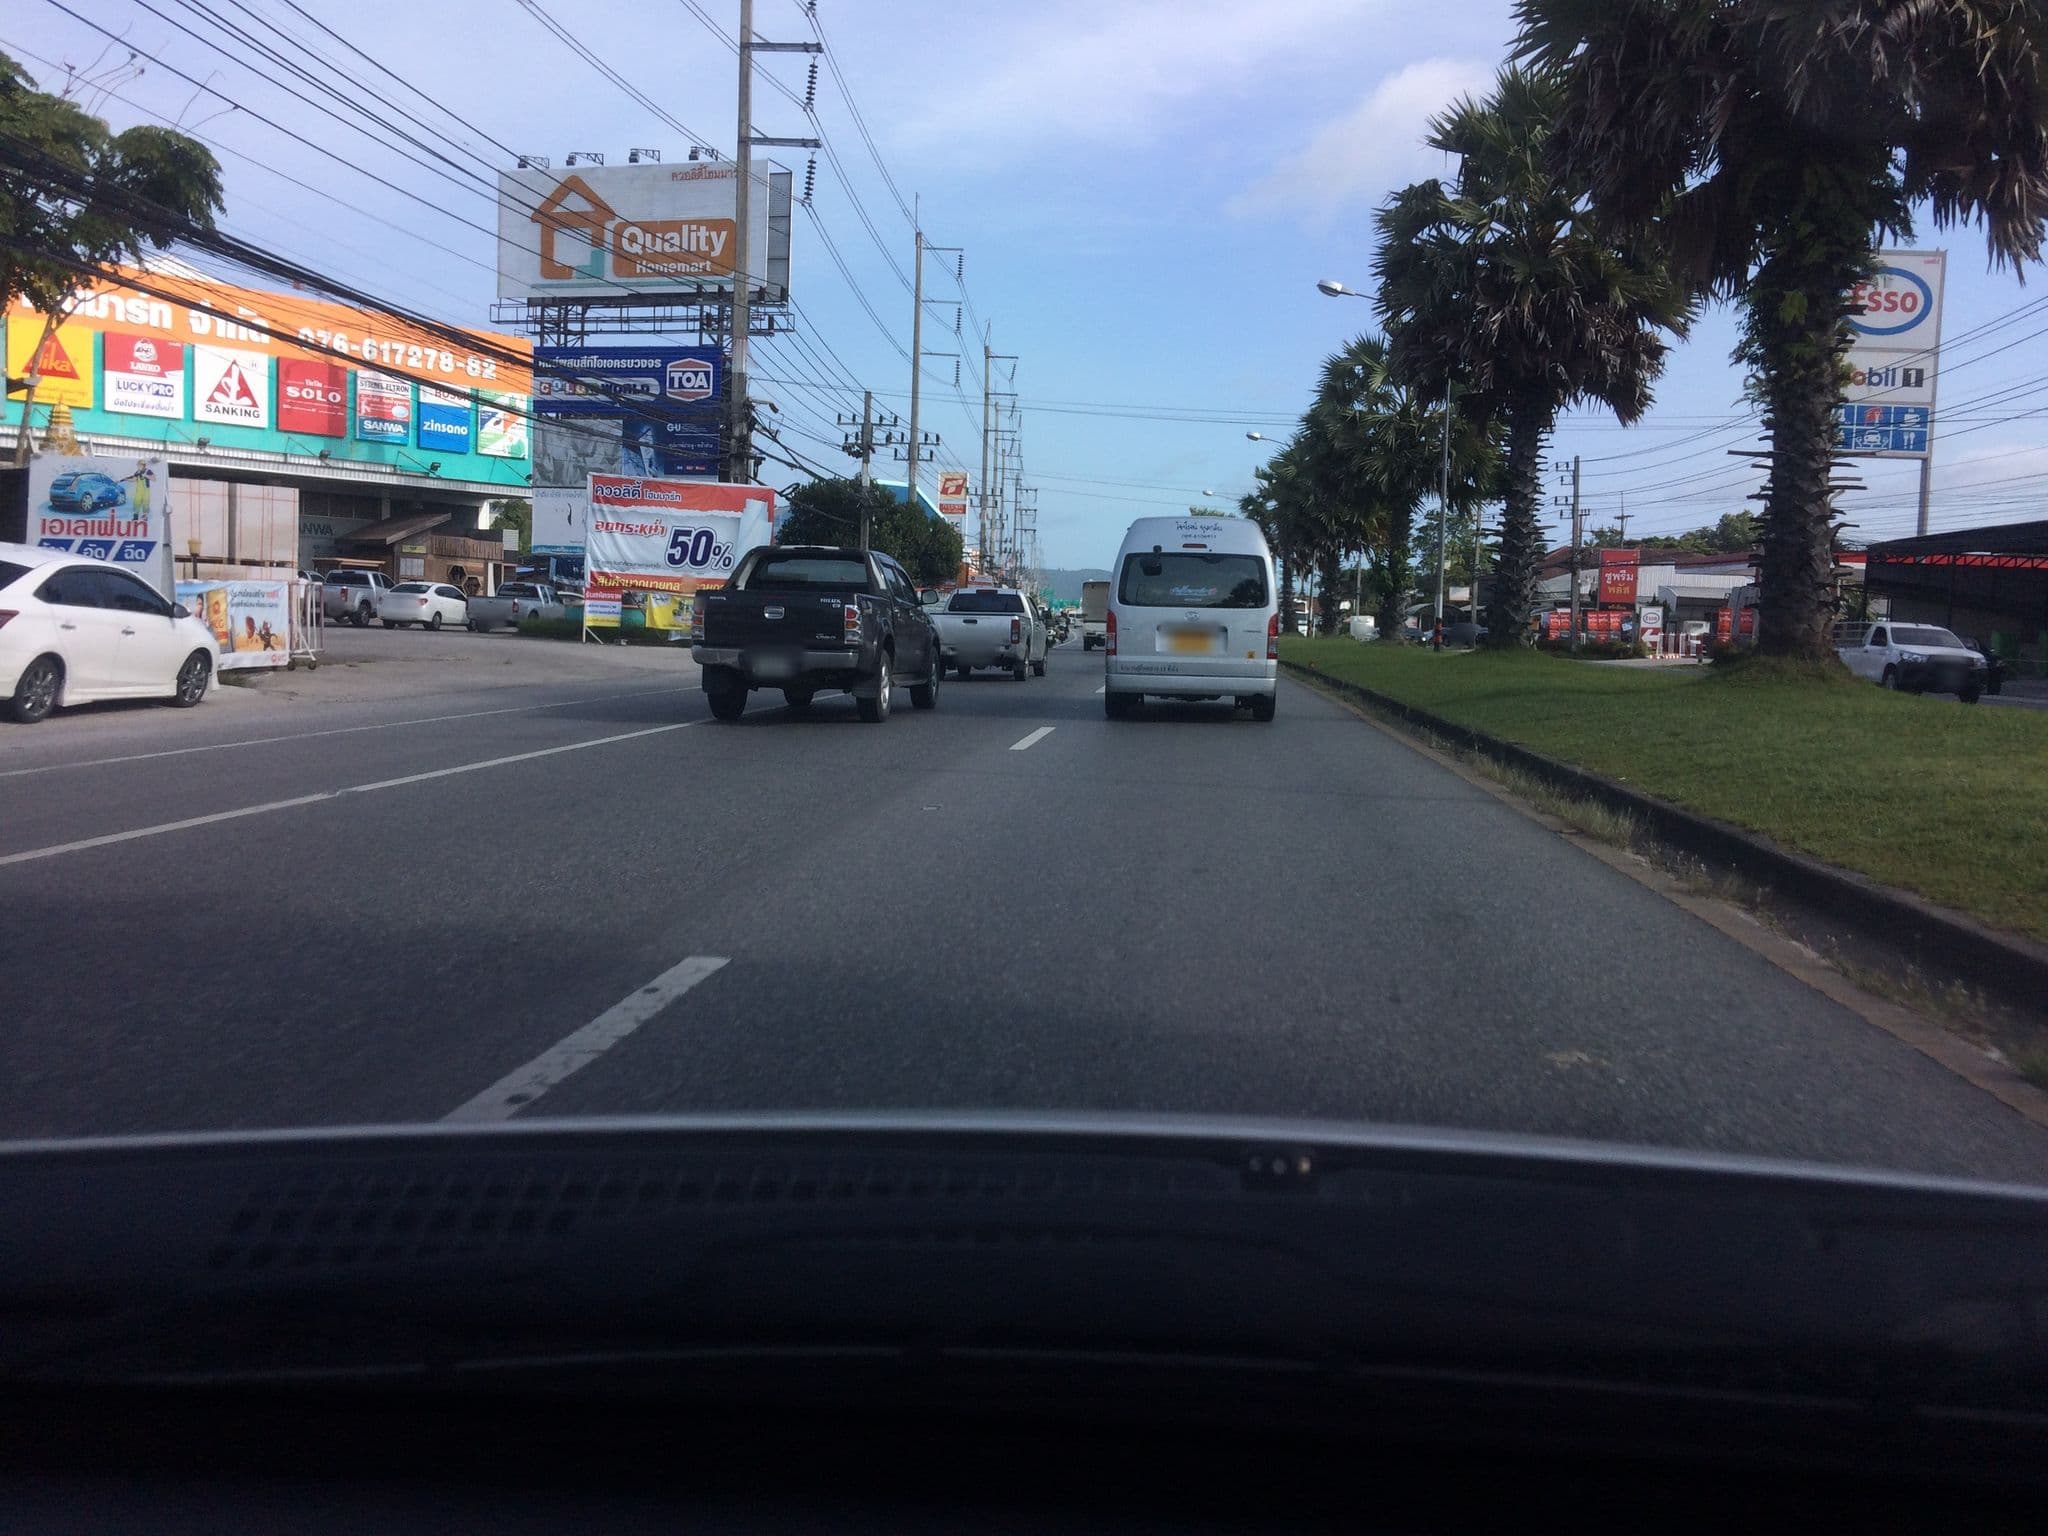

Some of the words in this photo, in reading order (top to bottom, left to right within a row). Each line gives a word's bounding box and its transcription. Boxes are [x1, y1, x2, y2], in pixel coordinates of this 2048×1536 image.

[621, 224, 728, 256] Quality
[635, 260, 713, 274] Homemart
[670, 372, 708, 389] TOA
[1850, 367, 1897, 388] obil
[286, 386, 342, 403] SOLO
[205, 403, 261, 419] SANKING
[363, 420, 404, 433] SANWA
[423, 419, 469, 435] zinsano
[301, 522, 335, 537] NWA
[123, 544, 146, 560] ฉีด
[666, 527, 735, 570] 50%
